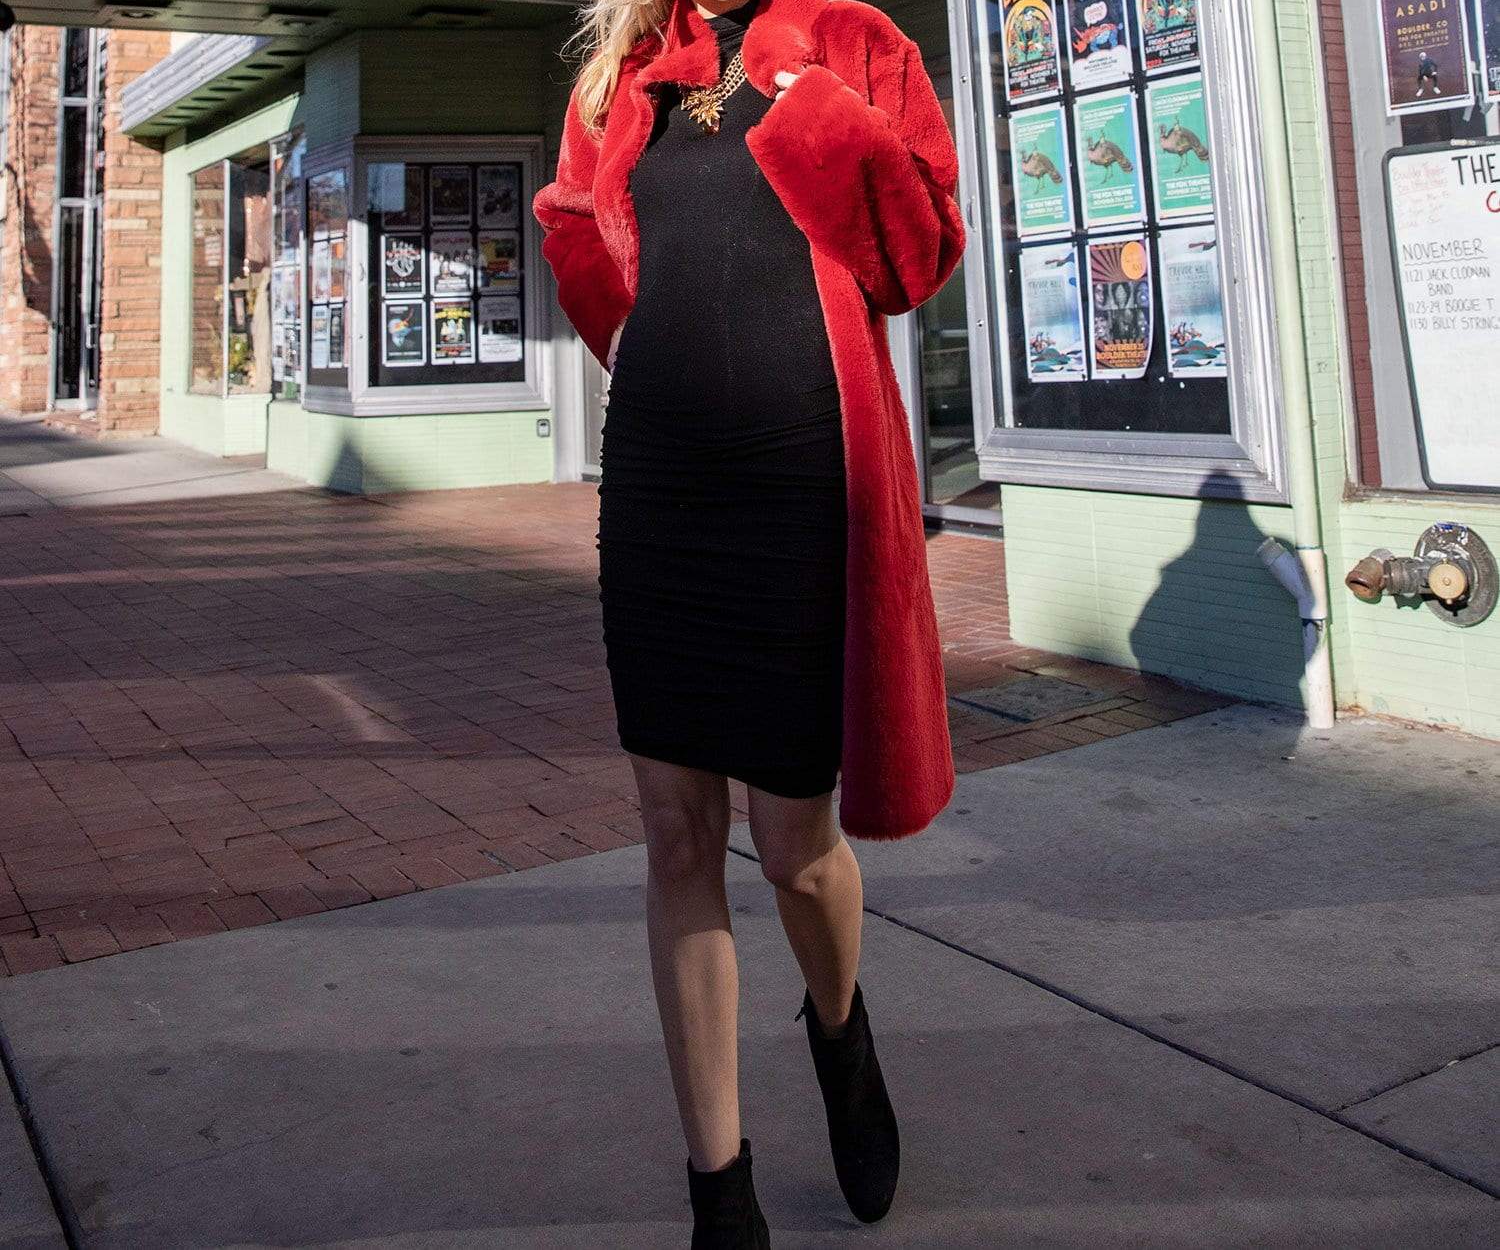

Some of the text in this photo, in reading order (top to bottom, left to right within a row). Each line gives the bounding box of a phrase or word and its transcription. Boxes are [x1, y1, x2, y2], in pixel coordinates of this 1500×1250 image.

[1451, 152, 1500, 185] THE
[1402, 238, 1485, 261] NOVEMBER
[1427, 282, 1454, 297] BAND
[1486, 297, 1495, 311] T
